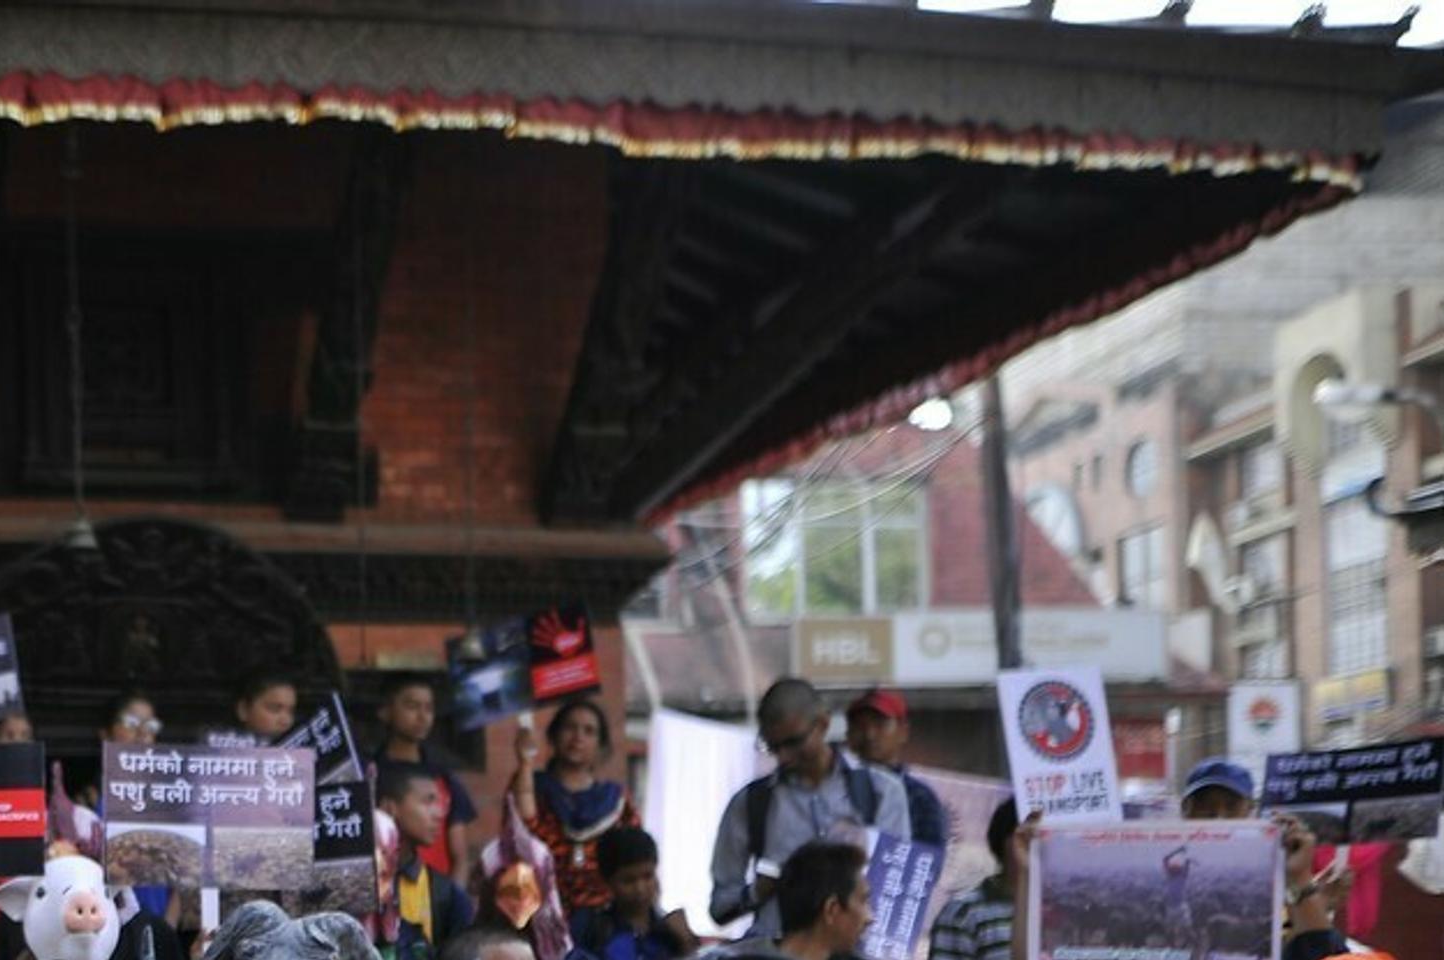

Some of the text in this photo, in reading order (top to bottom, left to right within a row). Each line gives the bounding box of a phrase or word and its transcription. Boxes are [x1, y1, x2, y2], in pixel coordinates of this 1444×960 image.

[811, 634, 881, 664] HBL
[118, 748, 184, 776] धर्मको
[188, 755, 256, 777] नाममा
[109, 779, 145, 812] पशु
